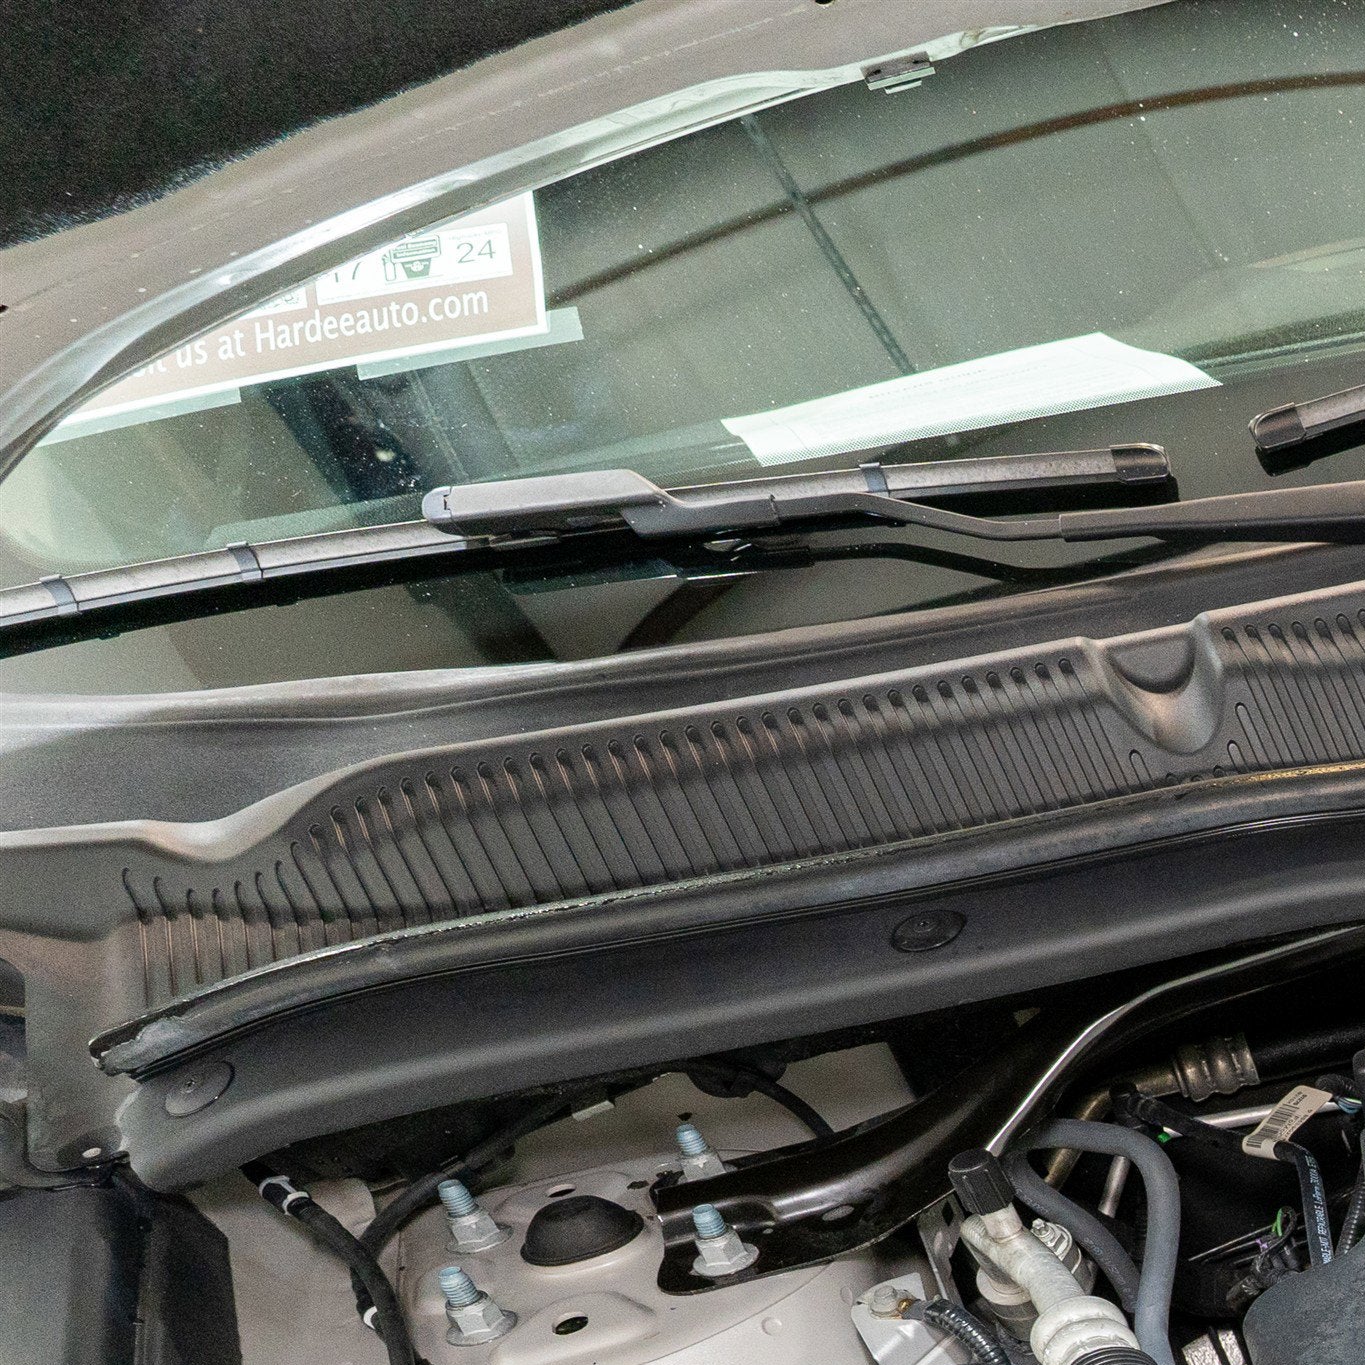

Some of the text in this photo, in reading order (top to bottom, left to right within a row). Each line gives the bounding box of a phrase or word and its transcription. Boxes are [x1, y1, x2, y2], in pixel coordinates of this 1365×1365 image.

[456, 240, 496, 265] 24
[175, 339, 208, 369] us
[218, 330, 246, 360] at
[254, 290, 489, 354] Hardeeauto.com
